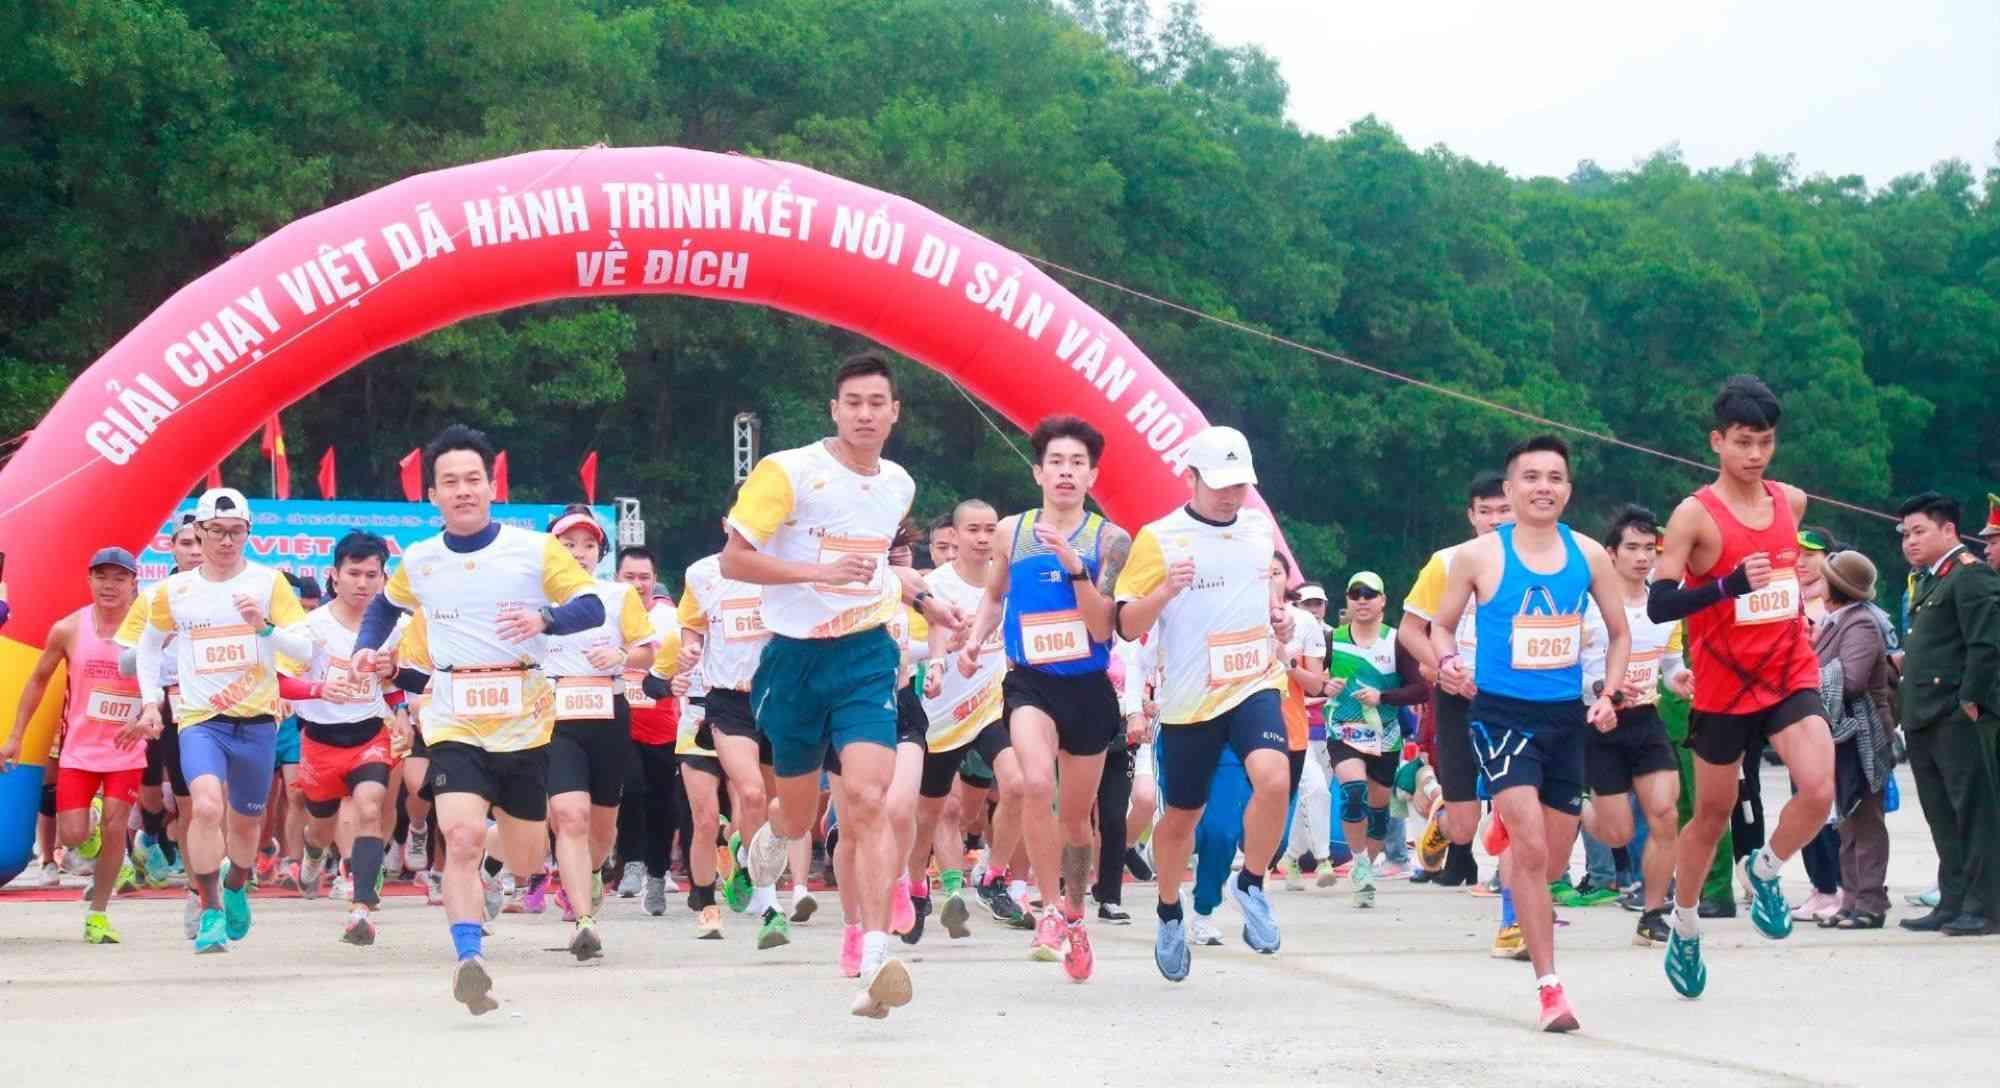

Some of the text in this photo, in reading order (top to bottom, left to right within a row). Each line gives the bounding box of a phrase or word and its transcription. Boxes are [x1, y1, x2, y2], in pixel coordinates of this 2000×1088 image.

[576, 230, 749, 289] VỀ ĐÍCH
[85, 379, 180, 465] GIẢI
[164, 287, 281, 387] CHẠY
[277, 238, 380, 316] VIỆT
[381, 202, 456, 272] DÃ
[463, 185, 590, 247] HÀNH
[602, 172, 732, 229] TRÌNH
[739, 179, 818, 241] KẾT
[830, 202, 905, 265] NỐI
[912, 232, 960, 286] DI
[1056, 320, 1136, 403] VĂN
[1126, 391, 1192, 478] HÓA
[249, 532, 334, 559] VIỆT
[1748, 590, 1789, 613] 6028
[1033, 631, 1076, 653] 6164
[1527, 637, 1571, 657] 6262
[206, 644, 245, 663] 6261
[1223, 650, 1260, 673] 6024
[465, 687, 509, 706] 6184
[565, 695, 604, 710] 6053
[100, 701, 131, 717] 6077
